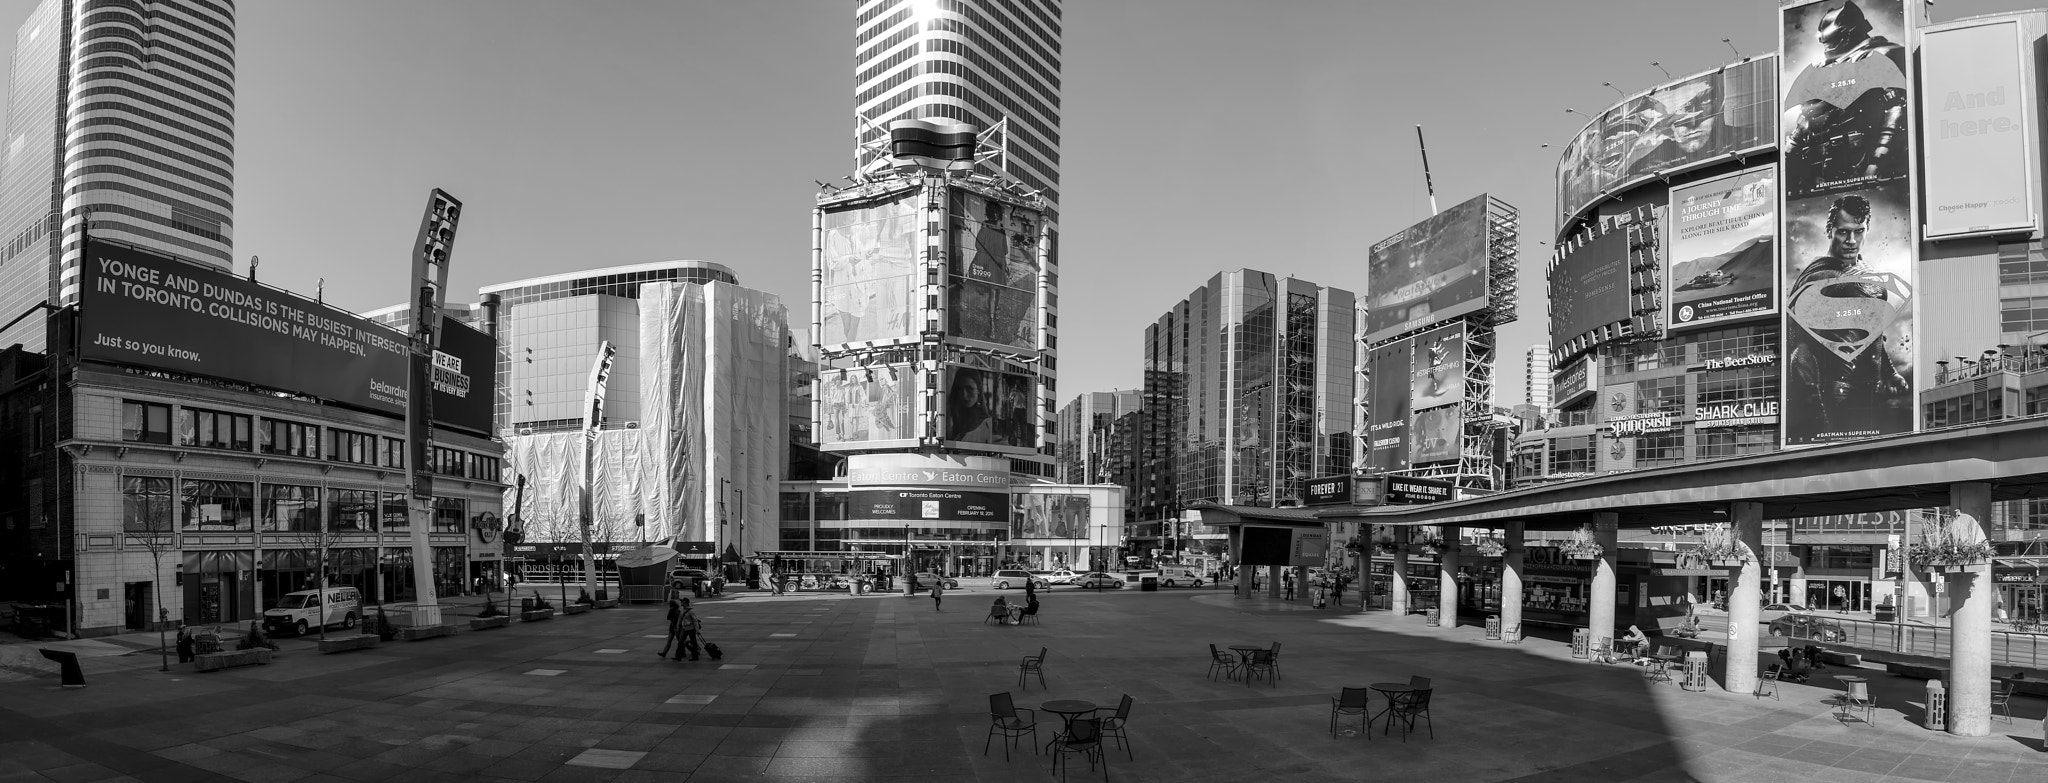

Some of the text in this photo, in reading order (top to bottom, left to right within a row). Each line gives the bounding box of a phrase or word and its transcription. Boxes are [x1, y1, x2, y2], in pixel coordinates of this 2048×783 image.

[1831, 78, 1856, 88] 3.25.16
[1944, 86, 2006, 112] And
[1940, 117, 2020, 139] here.
[1681, 207, 1688, 215] A
[1688, 200, 1721, 215] JOURNEY
[1681, 203, 1743, 223] THROUGH TIME
[1938, 204, 1964, 213] Choose
[1964, 201, 1989, 211] Happy
[1680, 212, 1765, 234] EXPLORE BEAUTIFUL CHINA
[1680, 221, 1749, 241] ALONG THE SILK ROAD
[99, 257, 409, 358] YONGE AND DUNDAS IS THE BUSIEST INTERSECTI
[1713, 297, 1733, 307] National
[1733, 295, 1751, 304] Tourist
[97, 276, 366, 358] IN TORONTO. COLLISIONS MAY HAPPEN.
[1404, 313, 1435, 332] SAMSUNG
[1835, 308, 1862, 318] 3.25.16
[94, 332, 201, 363] Just so you know.
[435, 351, 460, 372] WE ARE
[1705, 353, 1774, 370] The Beer Store
[369, 378, 409, 399] belairdire
[434, 367, 469, 391] BUSINESS
[1556, 367, 1586, 394] milestones
[433, 382, 440, 391] AT
[446, 386, 456, 396] VERY
[456, 388, 467, 398] BEST
[1695, 401, 1780, 421] SHARK CLUB
[1707, 420, 1731, 428] SPORTS
[850, 471, 1007, 485] Eaton Centre Eaton Centre
[1311, 481, 1345, 496] FOREVER 21
[1393, 482, 1403, 492] LIKE
[1410, 484, 1422, 493] WEAR
[1428, 486, 1442, 495] SHARE
[1760, 551, 1792, 562] AST
[327, 591, 356, 604] NELLA
